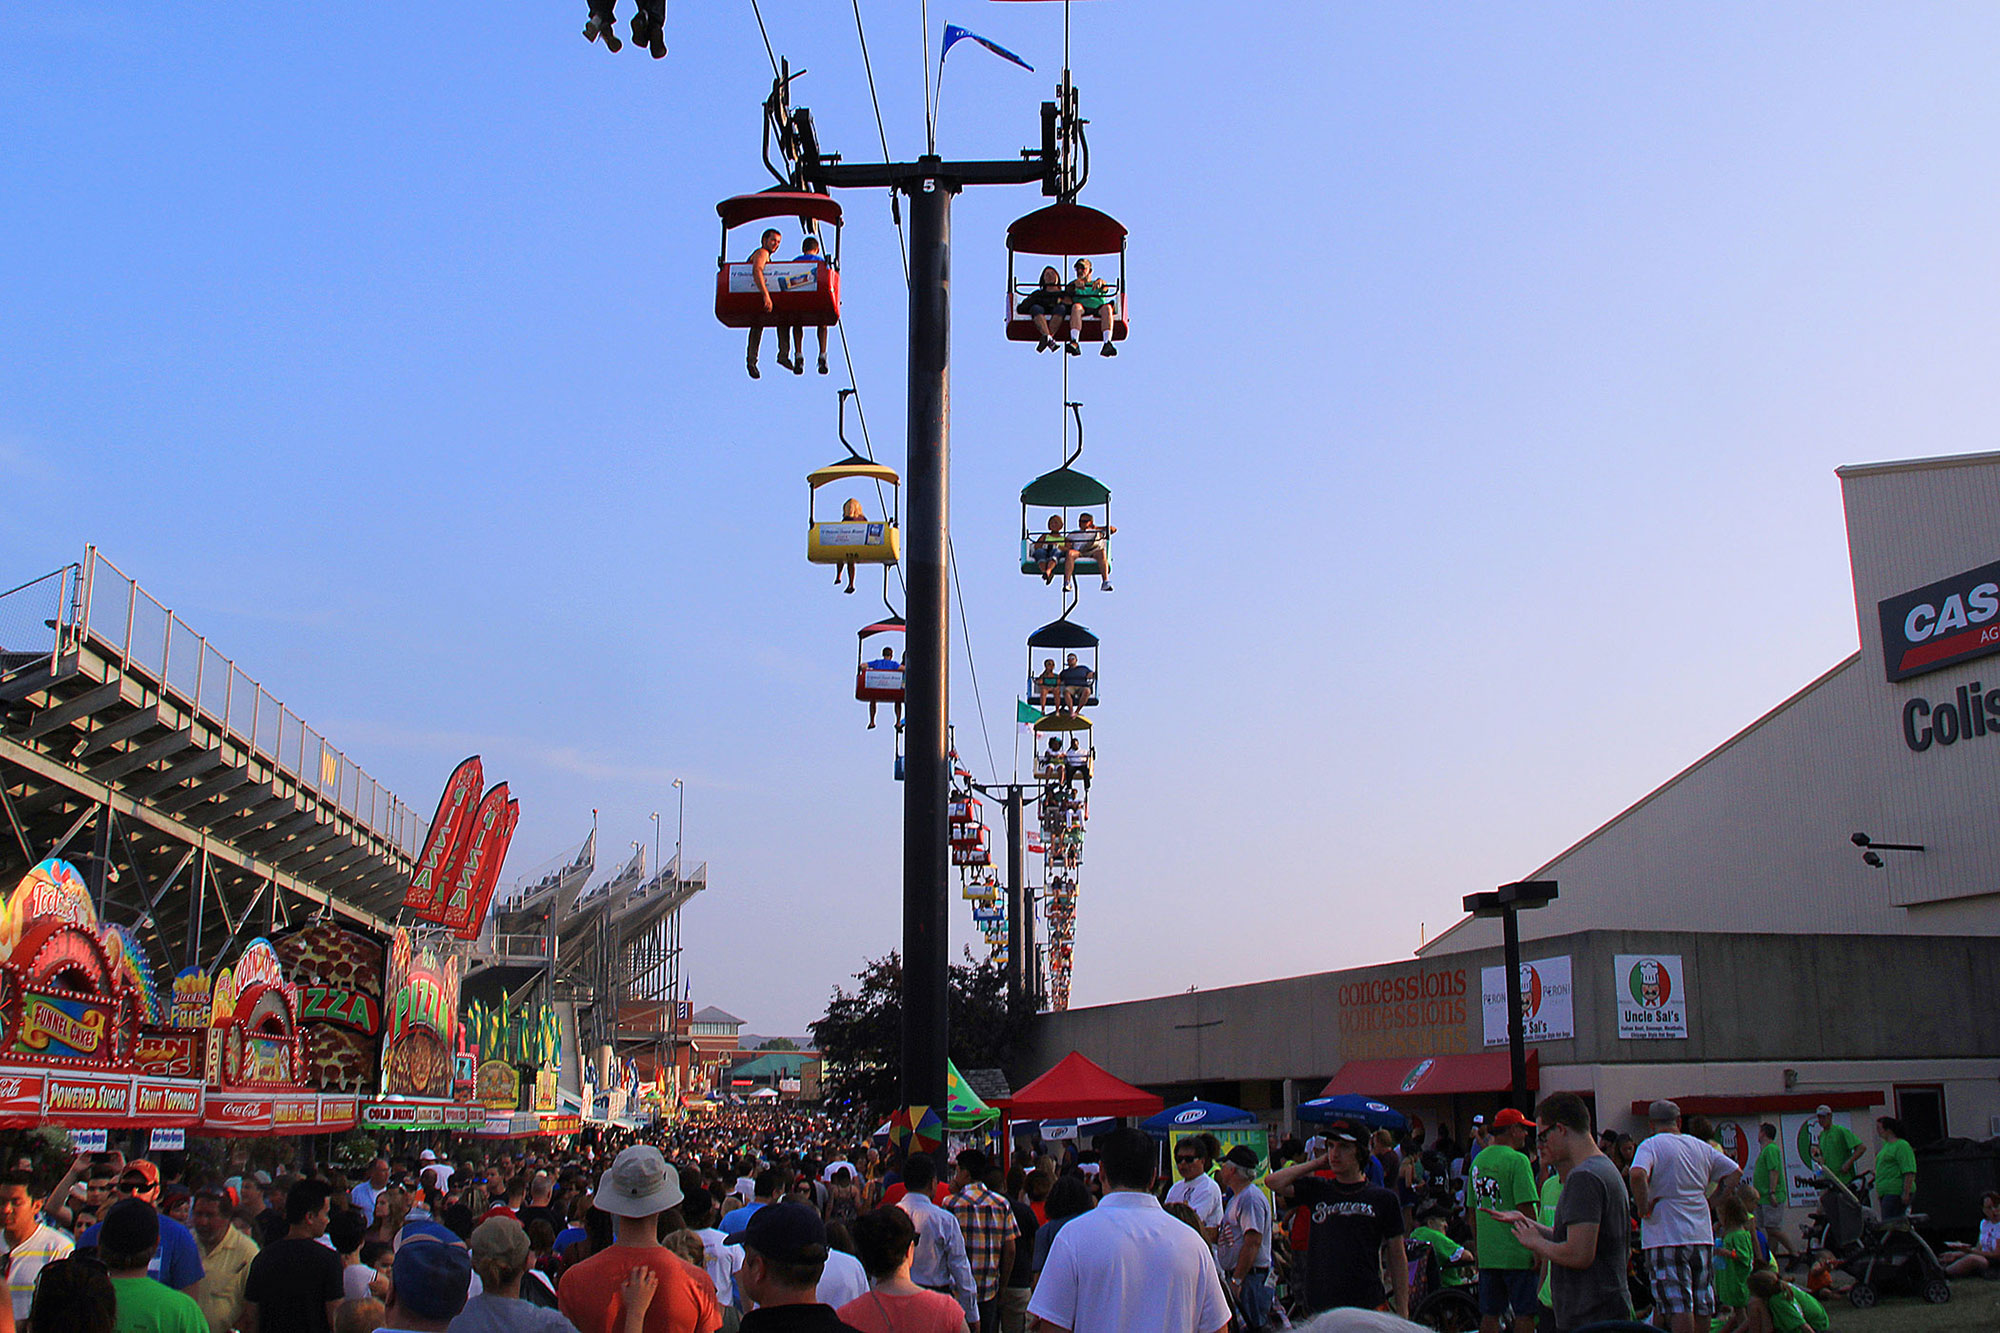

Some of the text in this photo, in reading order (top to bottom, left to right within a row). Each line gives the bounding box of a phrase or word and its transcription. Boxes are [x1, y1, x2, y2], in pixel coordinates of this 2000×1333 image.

[923, 179, 935, 192] 5
[1904, 582, 2000, 642] CAS
[1980, 626, 2000, 644] AG
[1339, 968, 1466, 1007] concessions
[1484, 992, 1506, 1006] PERON
[1543, 983, 1570, 998] PERONI
[170, 1005, 211, 1028] FRIES
[297, 986, 371, 1032] IZZA
[1339, 997, 1467, 1032] concessions
[1625, 1010, 1679, 1022] Uncle Sal's
[34, 1004, 96, 1050] FUNNEL CAKES
[1529, 1020, 1547, 1034] Sal's
[50, 1083, 127, 1111] POWERED SUGAR
[139, 1087, 197, 1112] FRUIT TOPPINGS
[368, 1107, 391, 1120] COLD
[1312, 1201, 1376, 1224] Brewers
